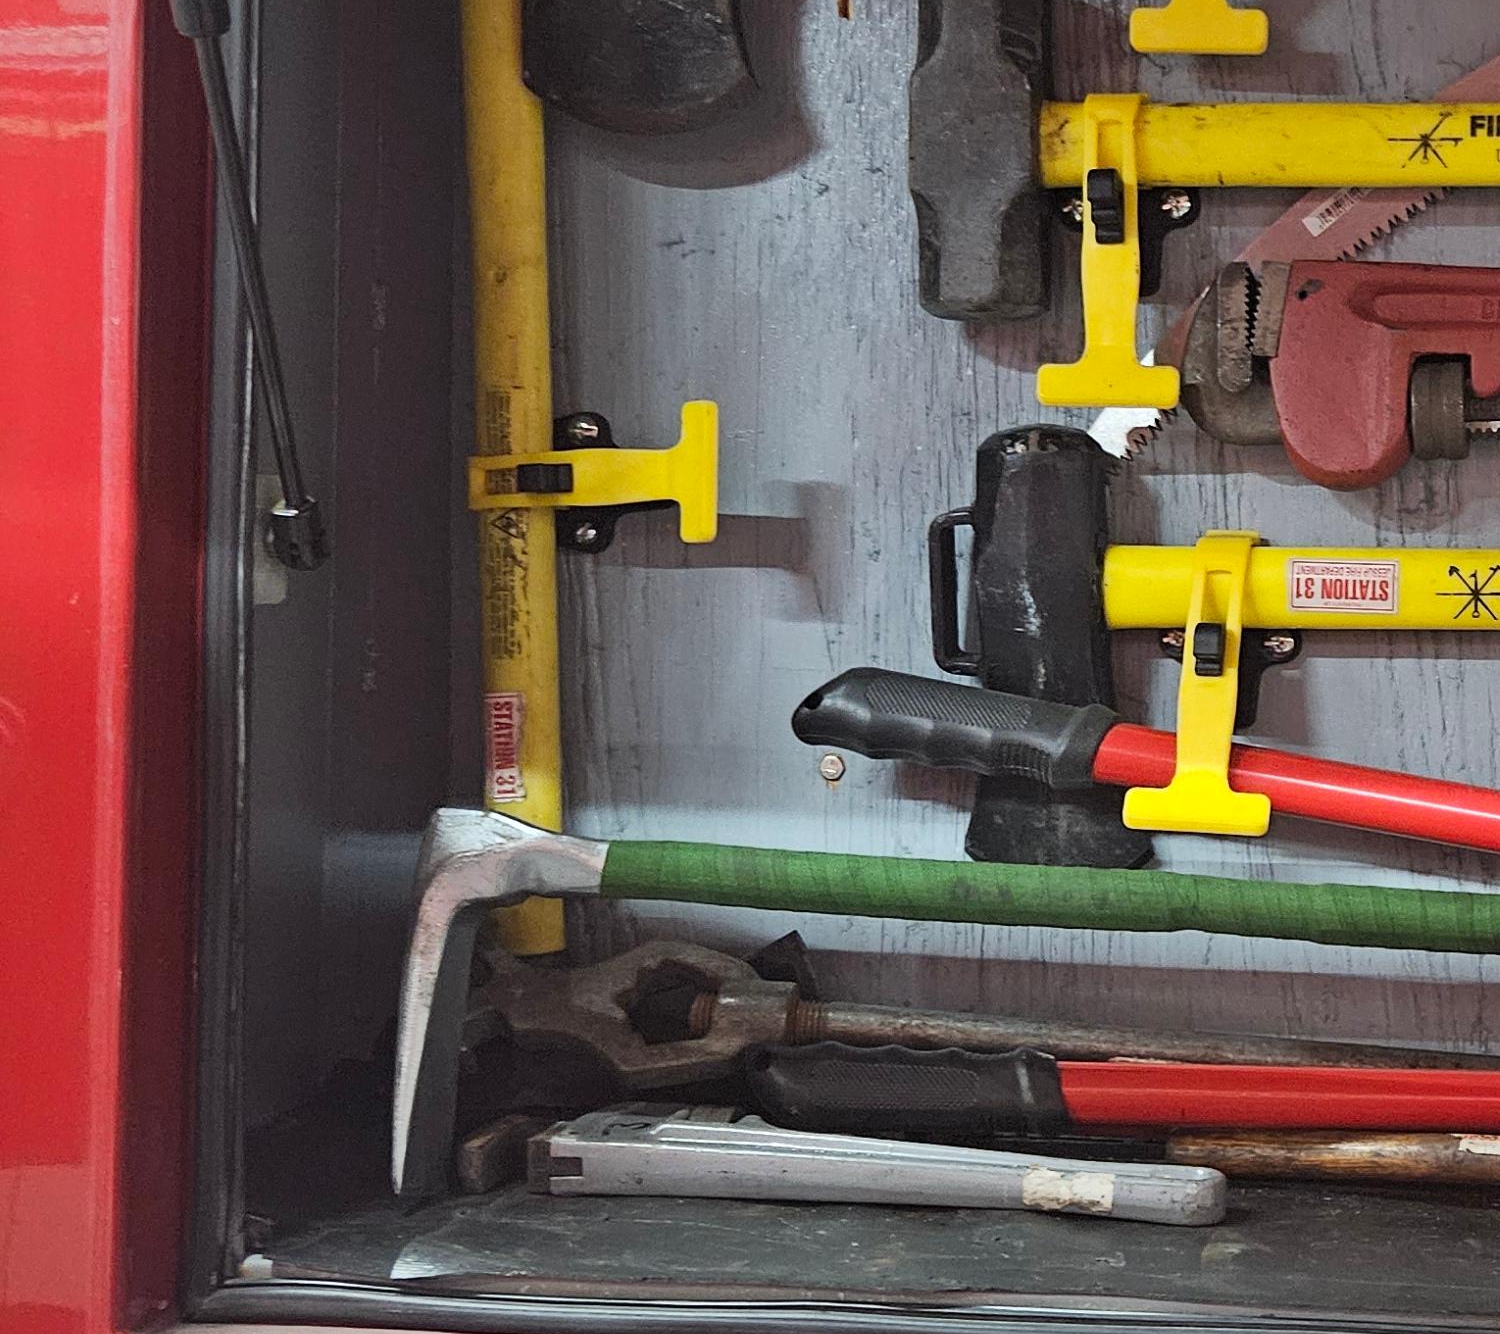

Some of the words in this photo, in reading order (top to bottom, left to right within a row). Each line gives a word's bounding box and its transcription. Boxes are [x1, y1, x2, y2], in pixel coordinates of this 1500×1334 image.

[1296, 577, 1315, 600] 31
[1321, 577, 1389, 602] STATION
[493, 699, 516, 770] STATION
